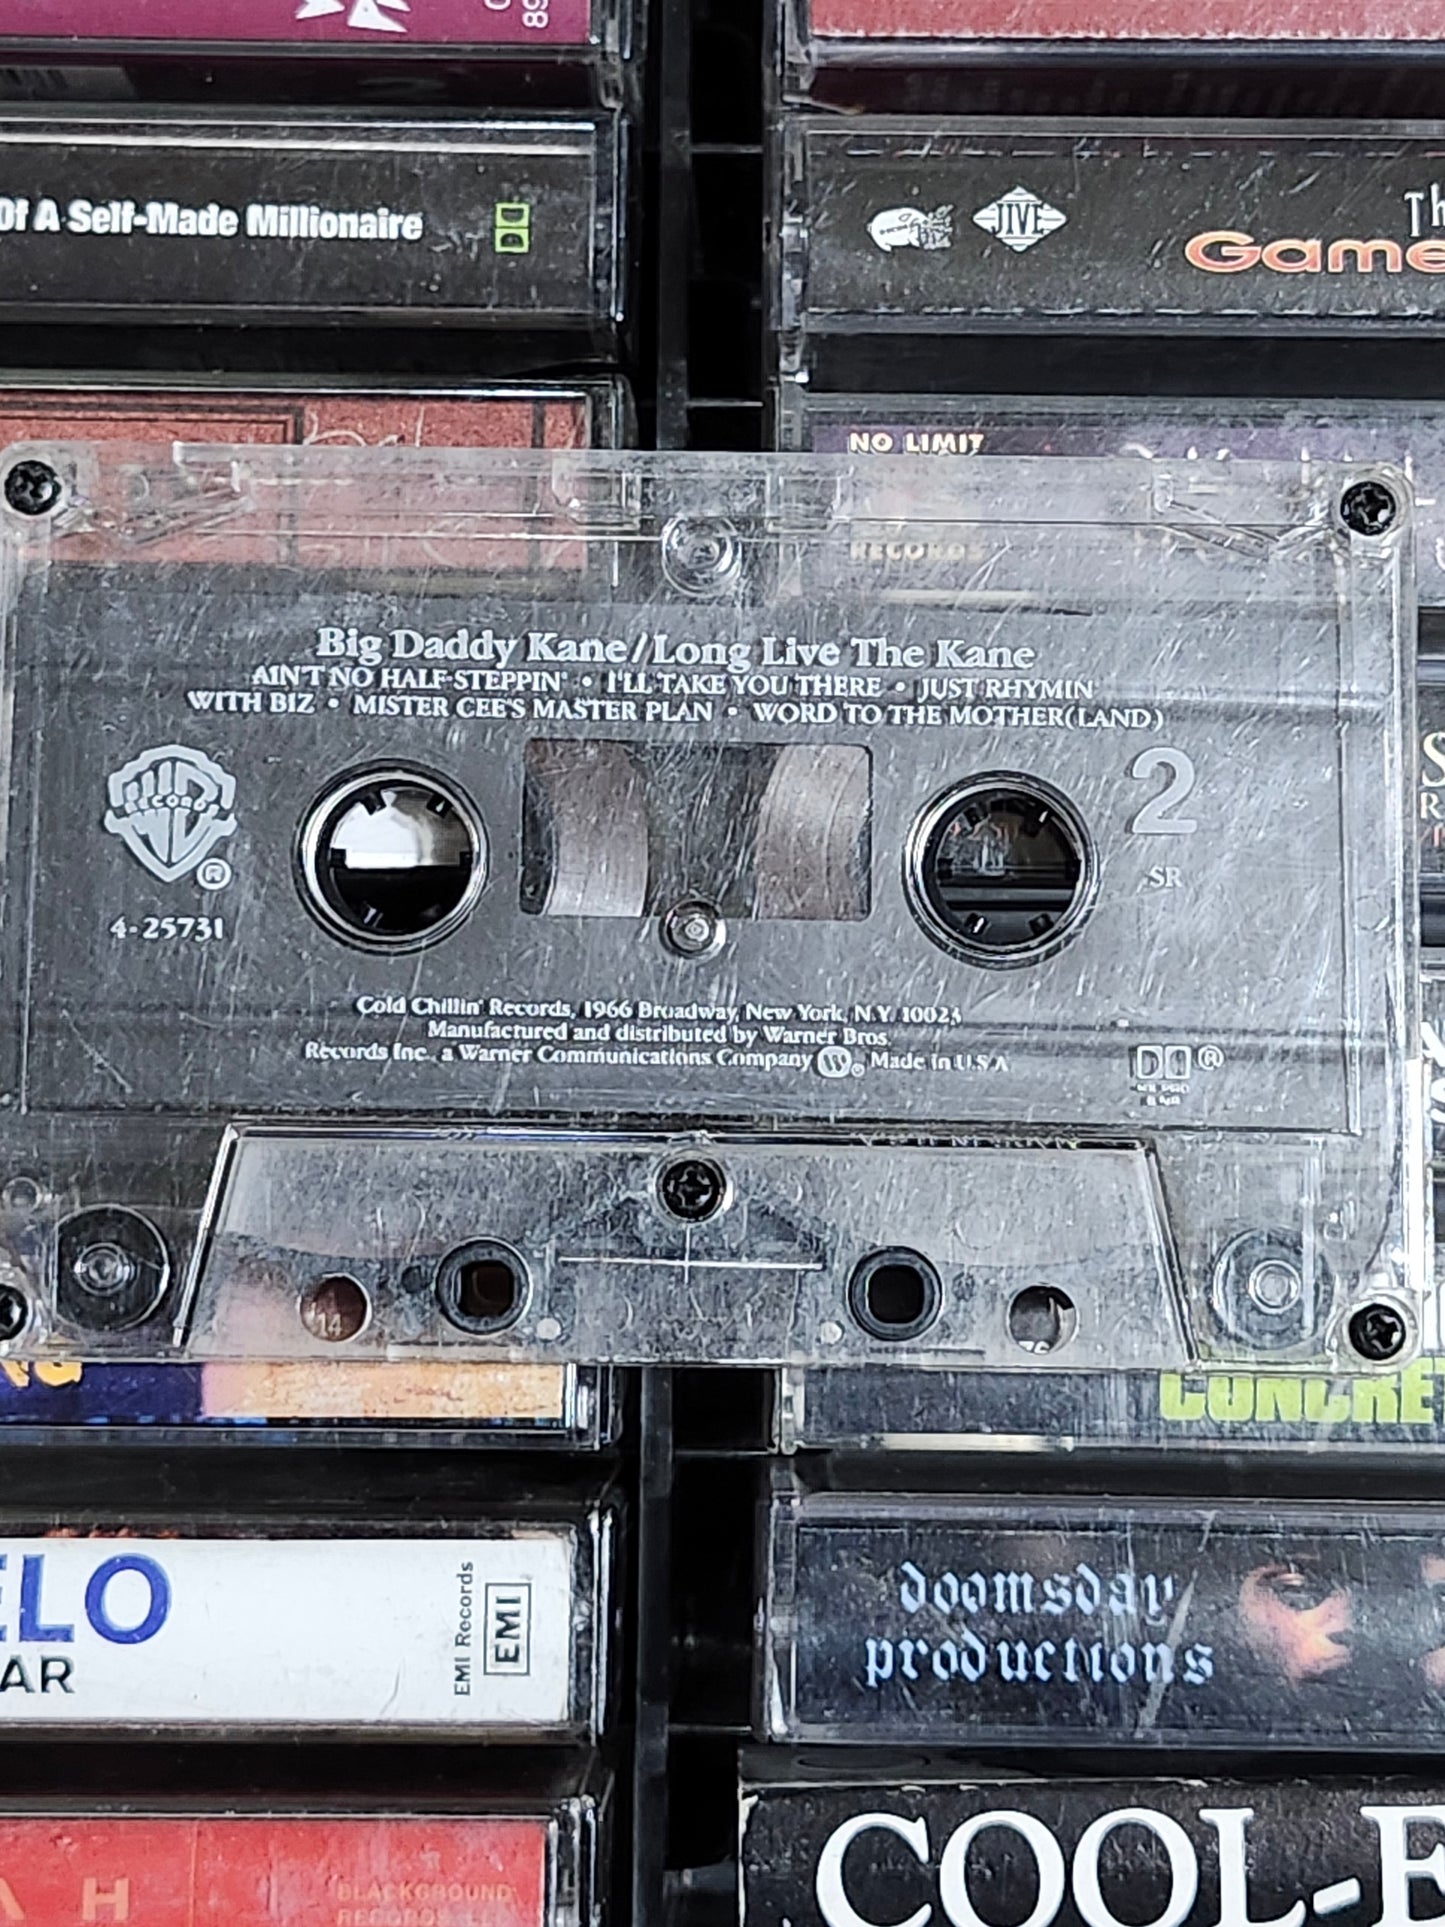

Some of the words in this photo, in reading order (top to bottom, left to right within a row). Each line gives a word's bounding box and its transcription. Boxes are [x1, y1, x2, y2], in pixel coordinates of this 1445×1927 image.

[34, 198, 61, 232] A
[67, 199, 239, 237] Self-Made
[246, 204, 423, 241] Millionaire
[991, 203, 1045, 235] JIVE
[850, 432, 893, 453] NO
[905, 432, 985, 455] LIMIT
[316, 627, 383, 667] Big
[391, 630, 514, 669] Daddy
[762, 636, 841, 668] Live
[850, 637, 925, 668] The
[935, 639, 1035, 669] Kane
[328, 666, 374, 688] NO
[607, 669, 652, 694] I'LL
[657, 671, 727, 695] TAKE
[732, 674, 789, 696] YOU
[795, 675, 882, 697] THERE
[917, 677, 979, 703] JUST
[187, 690, 262, 713] WITH
[269, 692, 316, 714] BIZ
[353, 694, 450, 716] MISTER
[456, 696, 526, 719] CEE'S
[533, 698, 638, 720] MASTER
[645, 700, 713, 722] PLAN
[753, 702, 838, 723] WORD
[843, 703, 882, 724] TO
[888, 705, 942, 725] THE
[1132, 746, 1197, 835] 2
[1147, 866, 1183, 888] SR
[110, 916, 224, 942] 4-25731
[356, 996, 406, 1014] Cold
[584, 1000, 633, 1018] 1966
[746, 1003, 793, 1020] New
[428, 1020, 567, 1040] Manufactured
[572, 1023, 610, 1041] and
[615, 1023, 727, 1043] distributed
[732, 1025, 758, 1049] by
[762, 1025, 838, 1045] Warner
[843, 1027, 892, 1047] Bros.
[305, 1041, 389, 1060] Records
[458, 1044, 532, 1063] Warner
[537, 1046, 712, 1066] Communications
[716, 1049, 814, 1073] Company
[871, 1051, 925, 1070] Made
[930, 1053, 952, 1071] in
[1160, 1357, 1445, 1424] CONCRE
[0, 1553, 172, 1645] LO
[455, 1561, 474, 1647] Records
[899, 1561, 1175, 1627] doomsday
[495, 1596, 521, 1663] EMI
[865, 1621, 1215, 1688] productions
[453, 1656, 471, 1696] EMI
